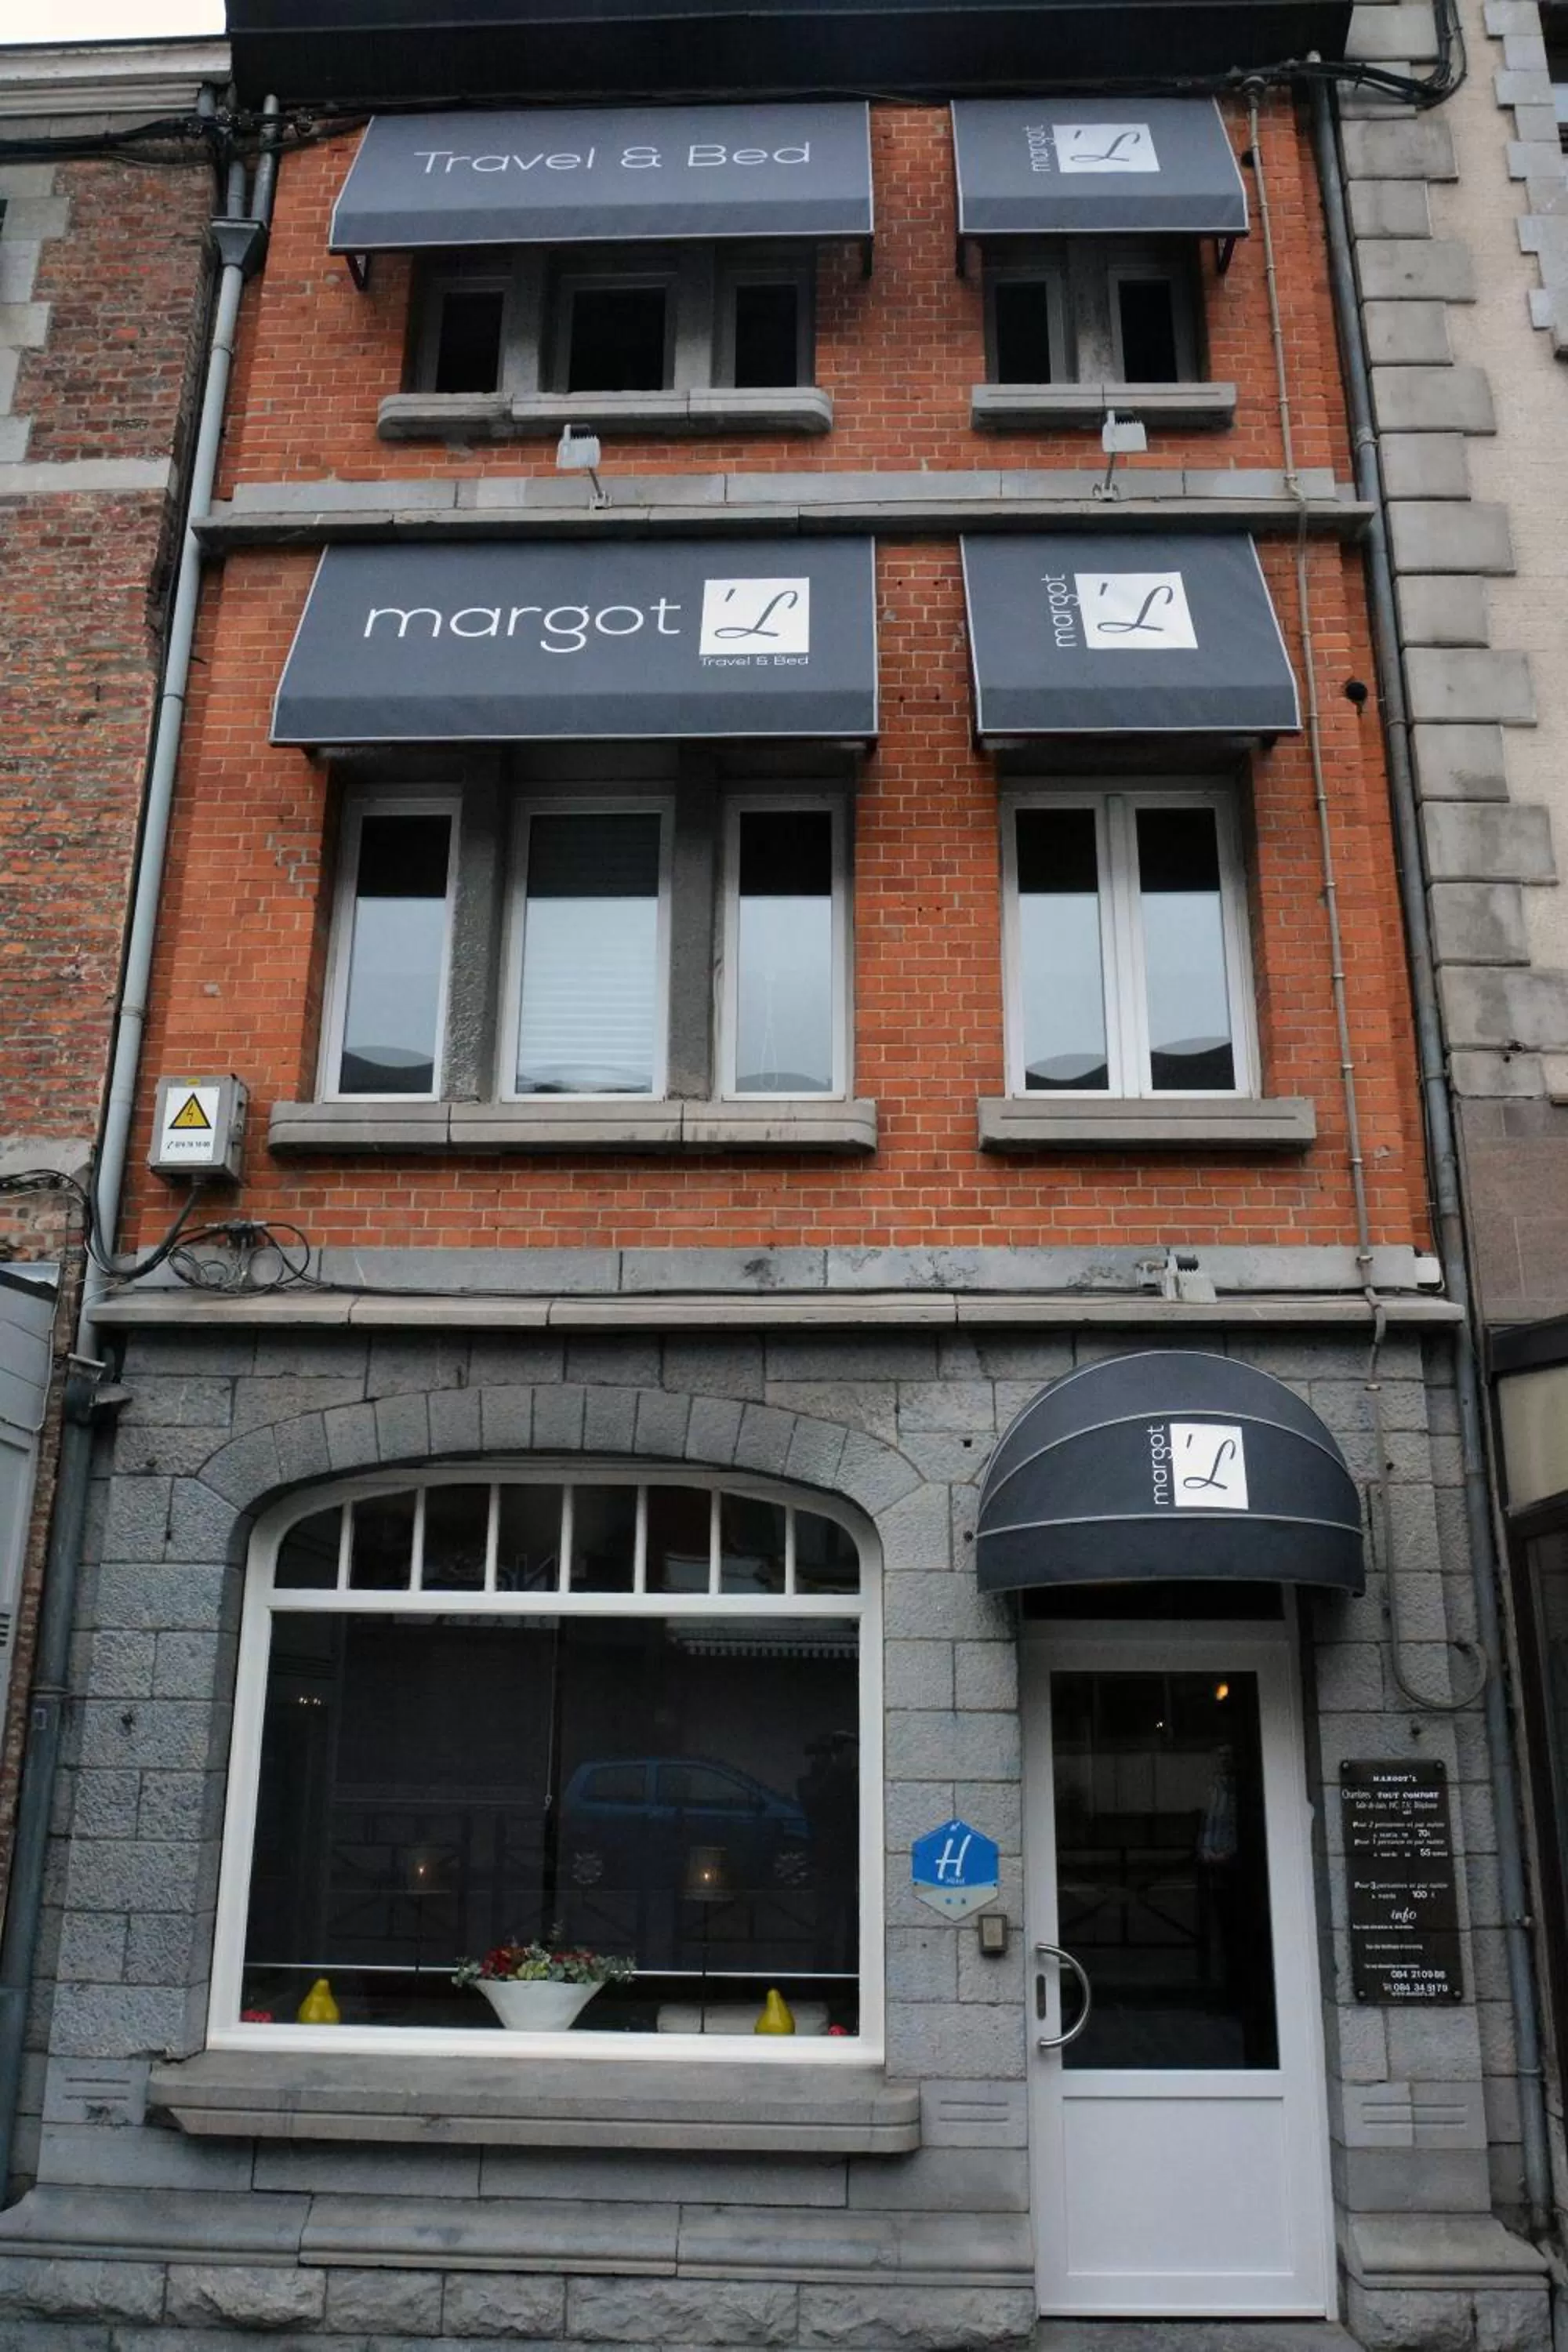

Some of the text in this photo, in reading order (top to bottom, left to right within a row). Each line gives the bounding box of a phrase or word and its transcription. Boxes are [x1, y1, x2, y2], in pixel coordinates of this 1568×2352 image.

[413, 141, 811, 174] Travel & Bed
[1023, 125, 1056, 172] margot
[363, 597, 681, 653] margot
[1041, 573, 1080, 648] margot
[702, 654, 809, 666] Travel & Bed
[1147, 1425, 1173, 1505] margot
[935, 1835, 972, 1879] H
